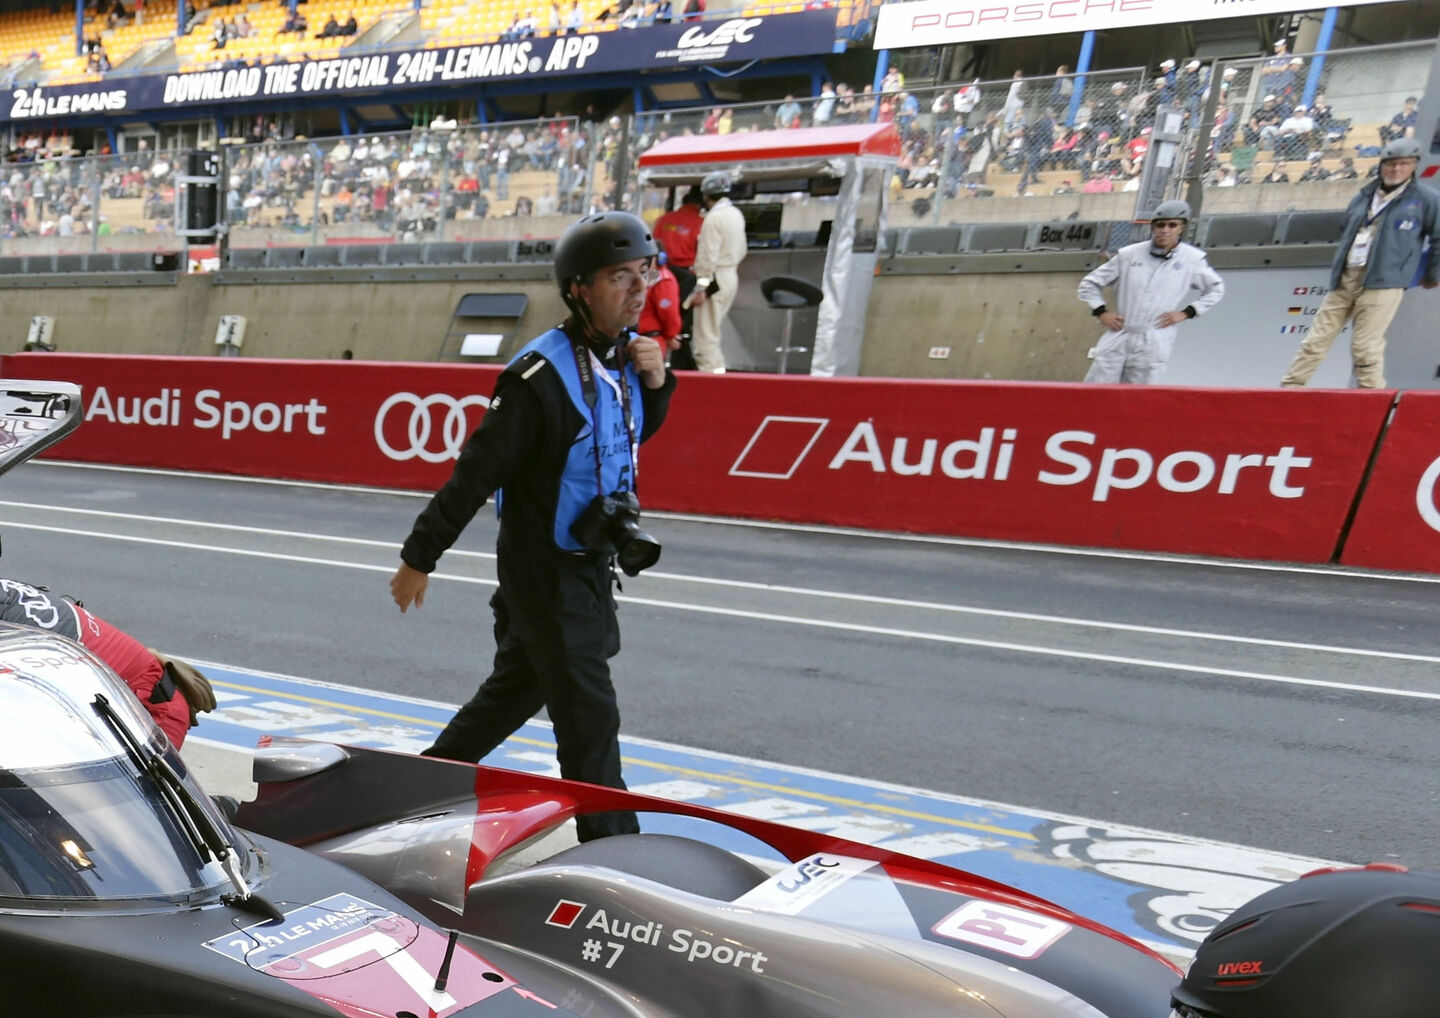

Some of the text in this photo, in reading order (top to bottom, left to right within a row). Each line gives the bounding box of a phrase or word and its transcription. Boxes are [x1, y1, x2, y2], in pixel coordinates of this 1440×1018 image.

[163, 68, 262, 104] DOWNLOAD
[263, 65, 298, 94] THE
[301, 55, 390, 91] OFFICIAL
[545, 35, 600, 72] APP
[46, 99, 70, 114] LE
[71, 90, 127, 112] MANS
[1040, 227, 1065, 243] Box
[85, 386, 327, 440] Audi Sport
[829, 420, 1312, 502] Audi Sport
[767, 857, 840, 893] WEC
[279, 922, 312, 941] LE
[311, 901, 368, 930] MANS
[957, 909, 1046, 946] P1
[581, 938, 624, 976] #7
[587, 908, 768, 974] Audi Sport
[306, 931, 458, 1014] 7
[1218, 961, 1262, 975] uvex
